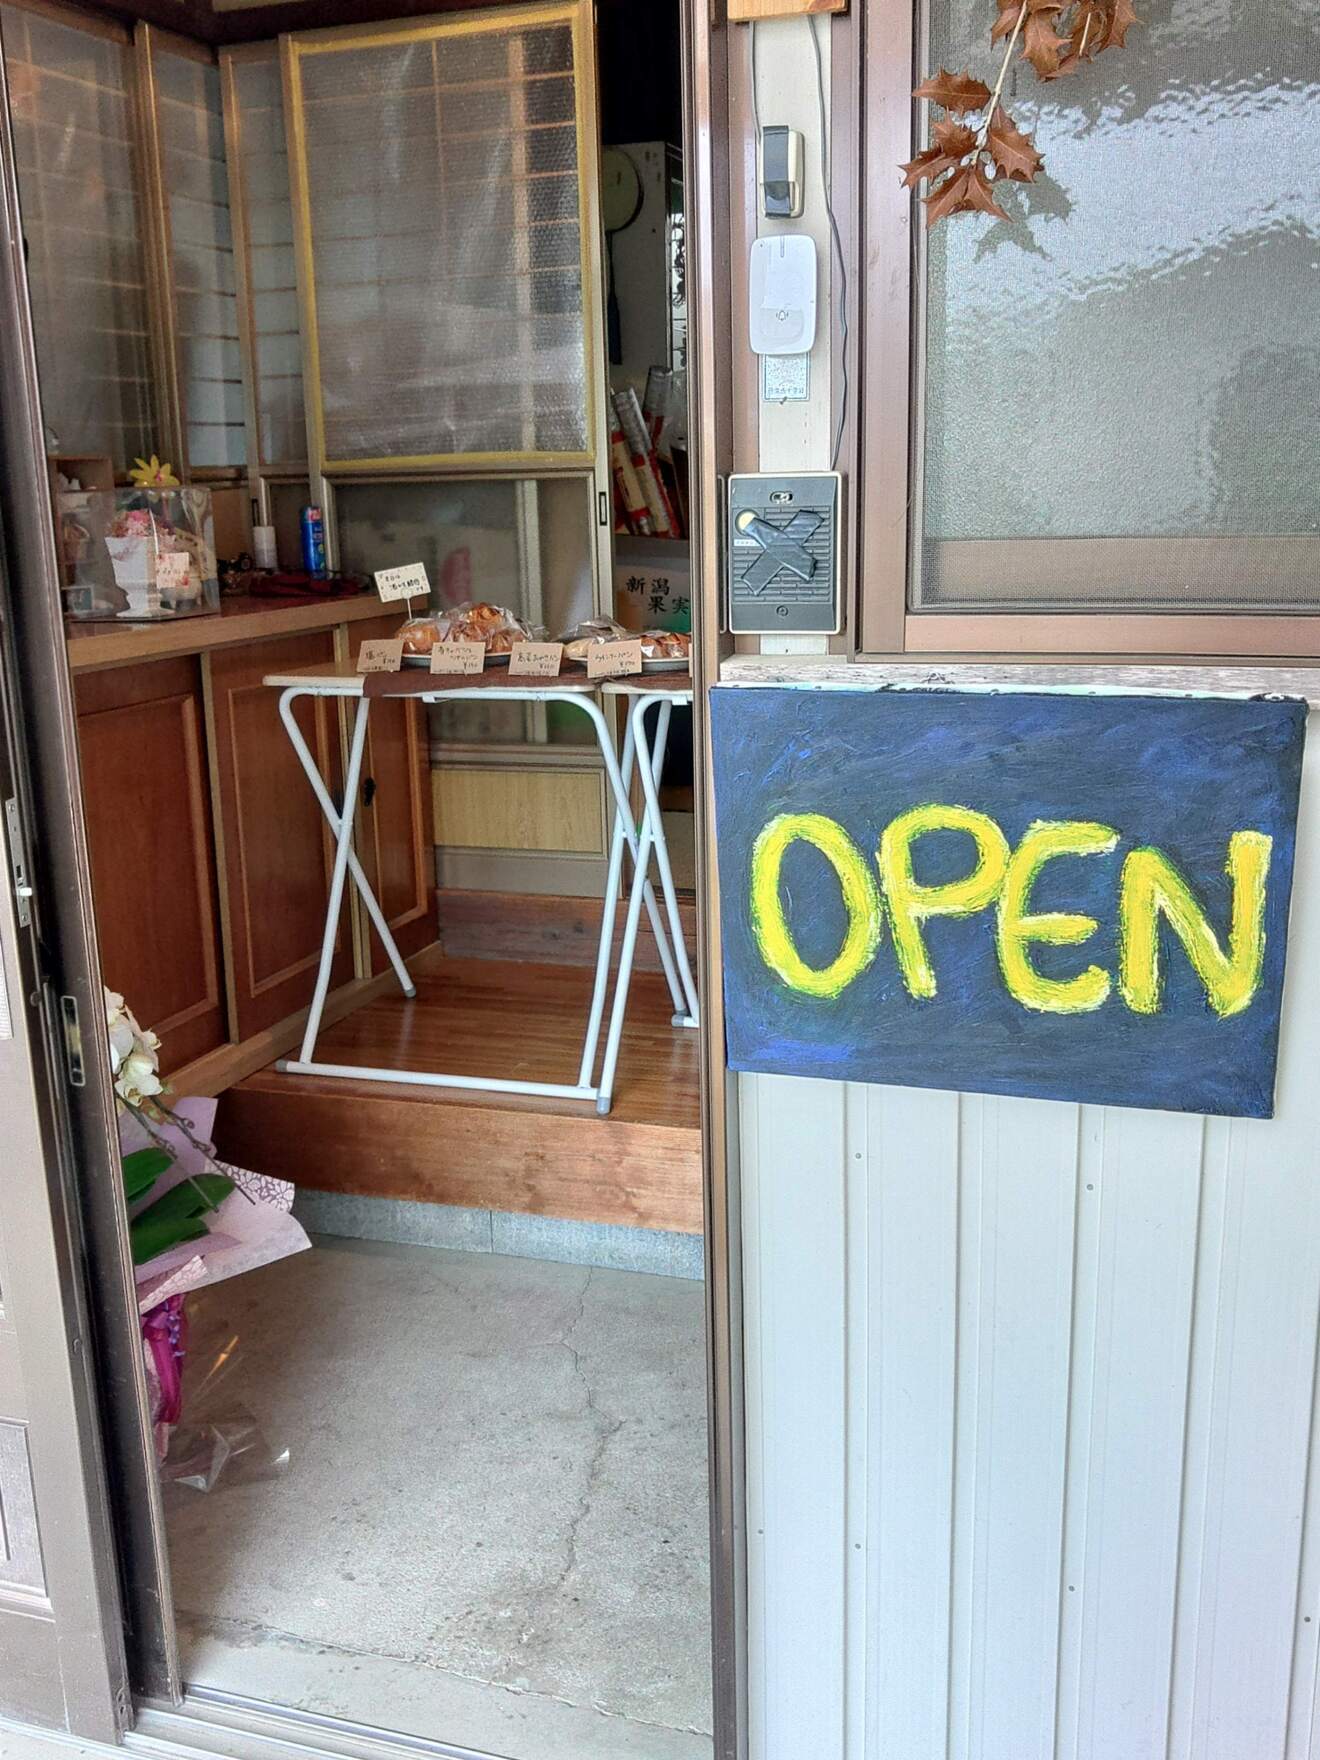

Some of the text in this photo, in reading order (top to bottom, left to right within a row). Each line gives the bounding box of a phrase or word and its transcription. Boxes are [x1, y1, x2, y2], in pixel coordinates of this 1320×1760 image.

[626, 576, 670, 596] 新潟
[647, 596, 689, 615] 果実
[751, 802, 1273, 1020] OPEN
